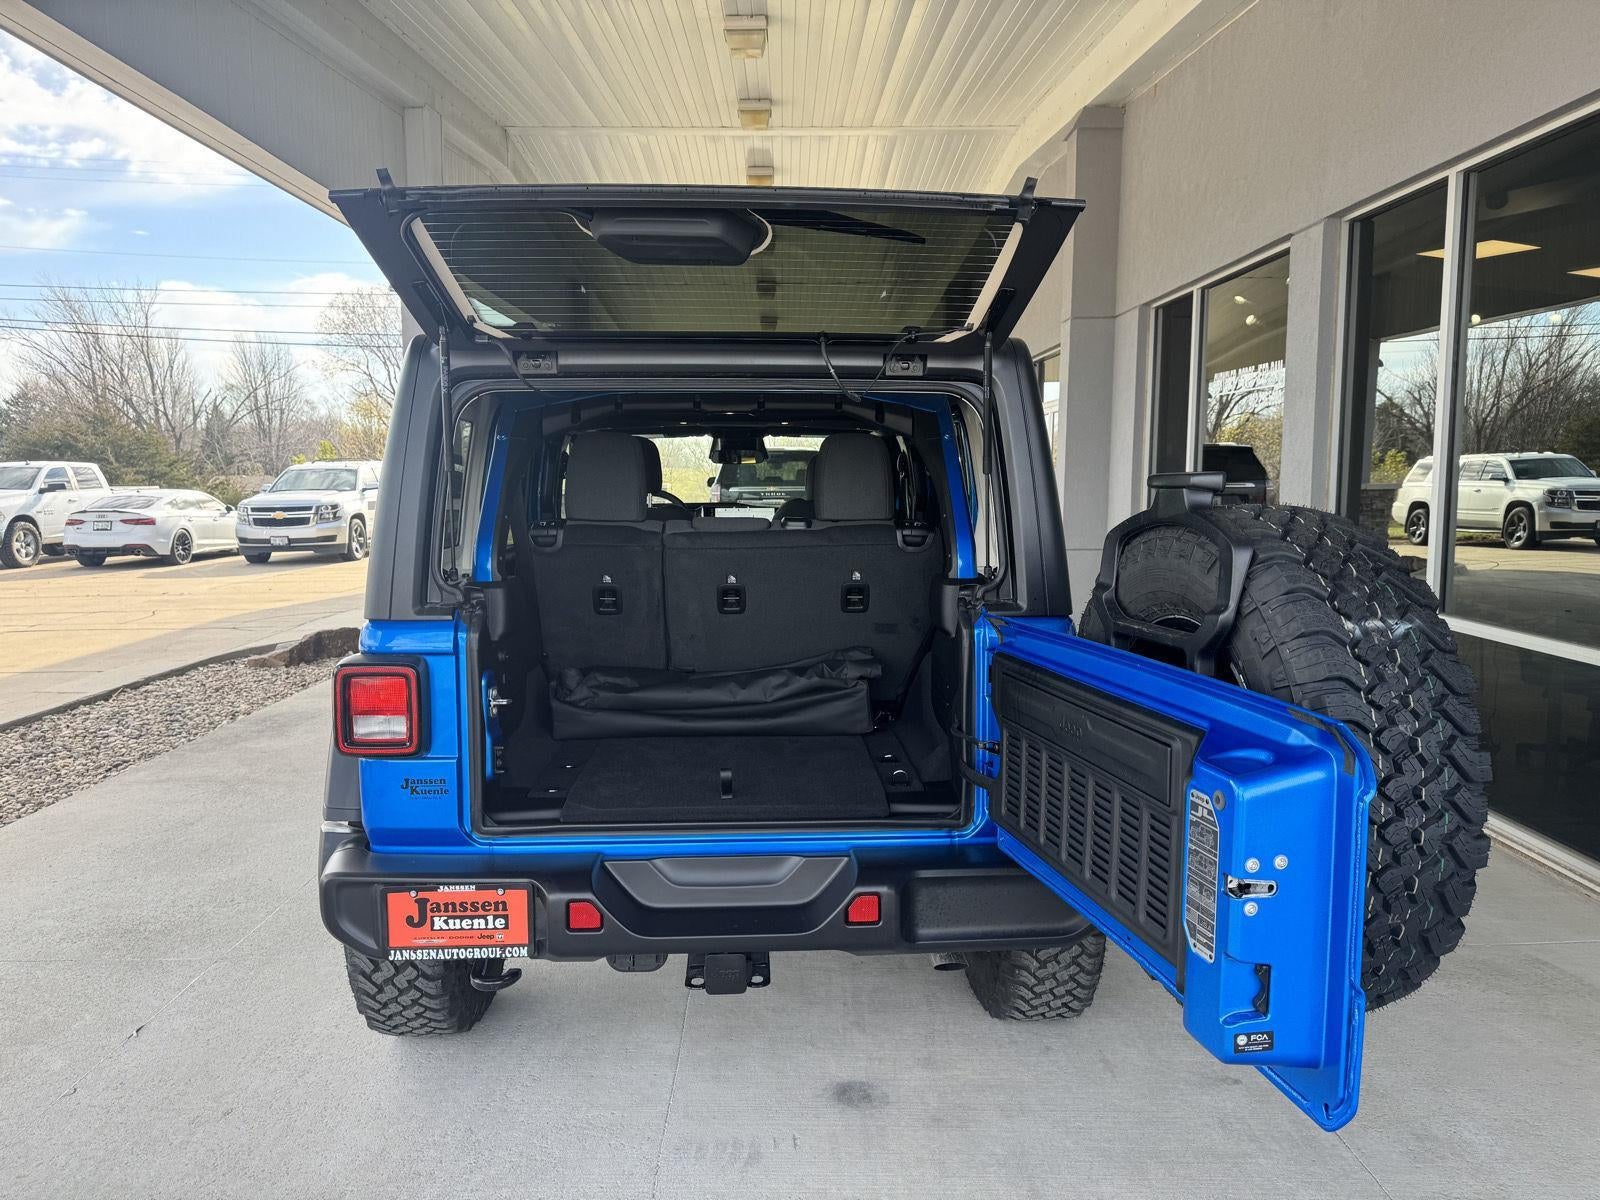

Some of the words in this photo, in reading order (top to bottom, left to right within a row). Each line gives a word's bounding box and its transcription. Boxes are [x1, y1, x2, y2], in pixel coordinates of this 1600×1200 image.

[400, 777, 447, 790] Janssen
[410, 785, 450, 795] Kuenle
[1190, 804, 1215, 822] JL
[437, 884, 476, 893] JANSSEN
[405, 897, 509, 929] Janssen
[432, 915, 506, 931] Kuenle
[1250, 1033, 1269, 1042] FCA
